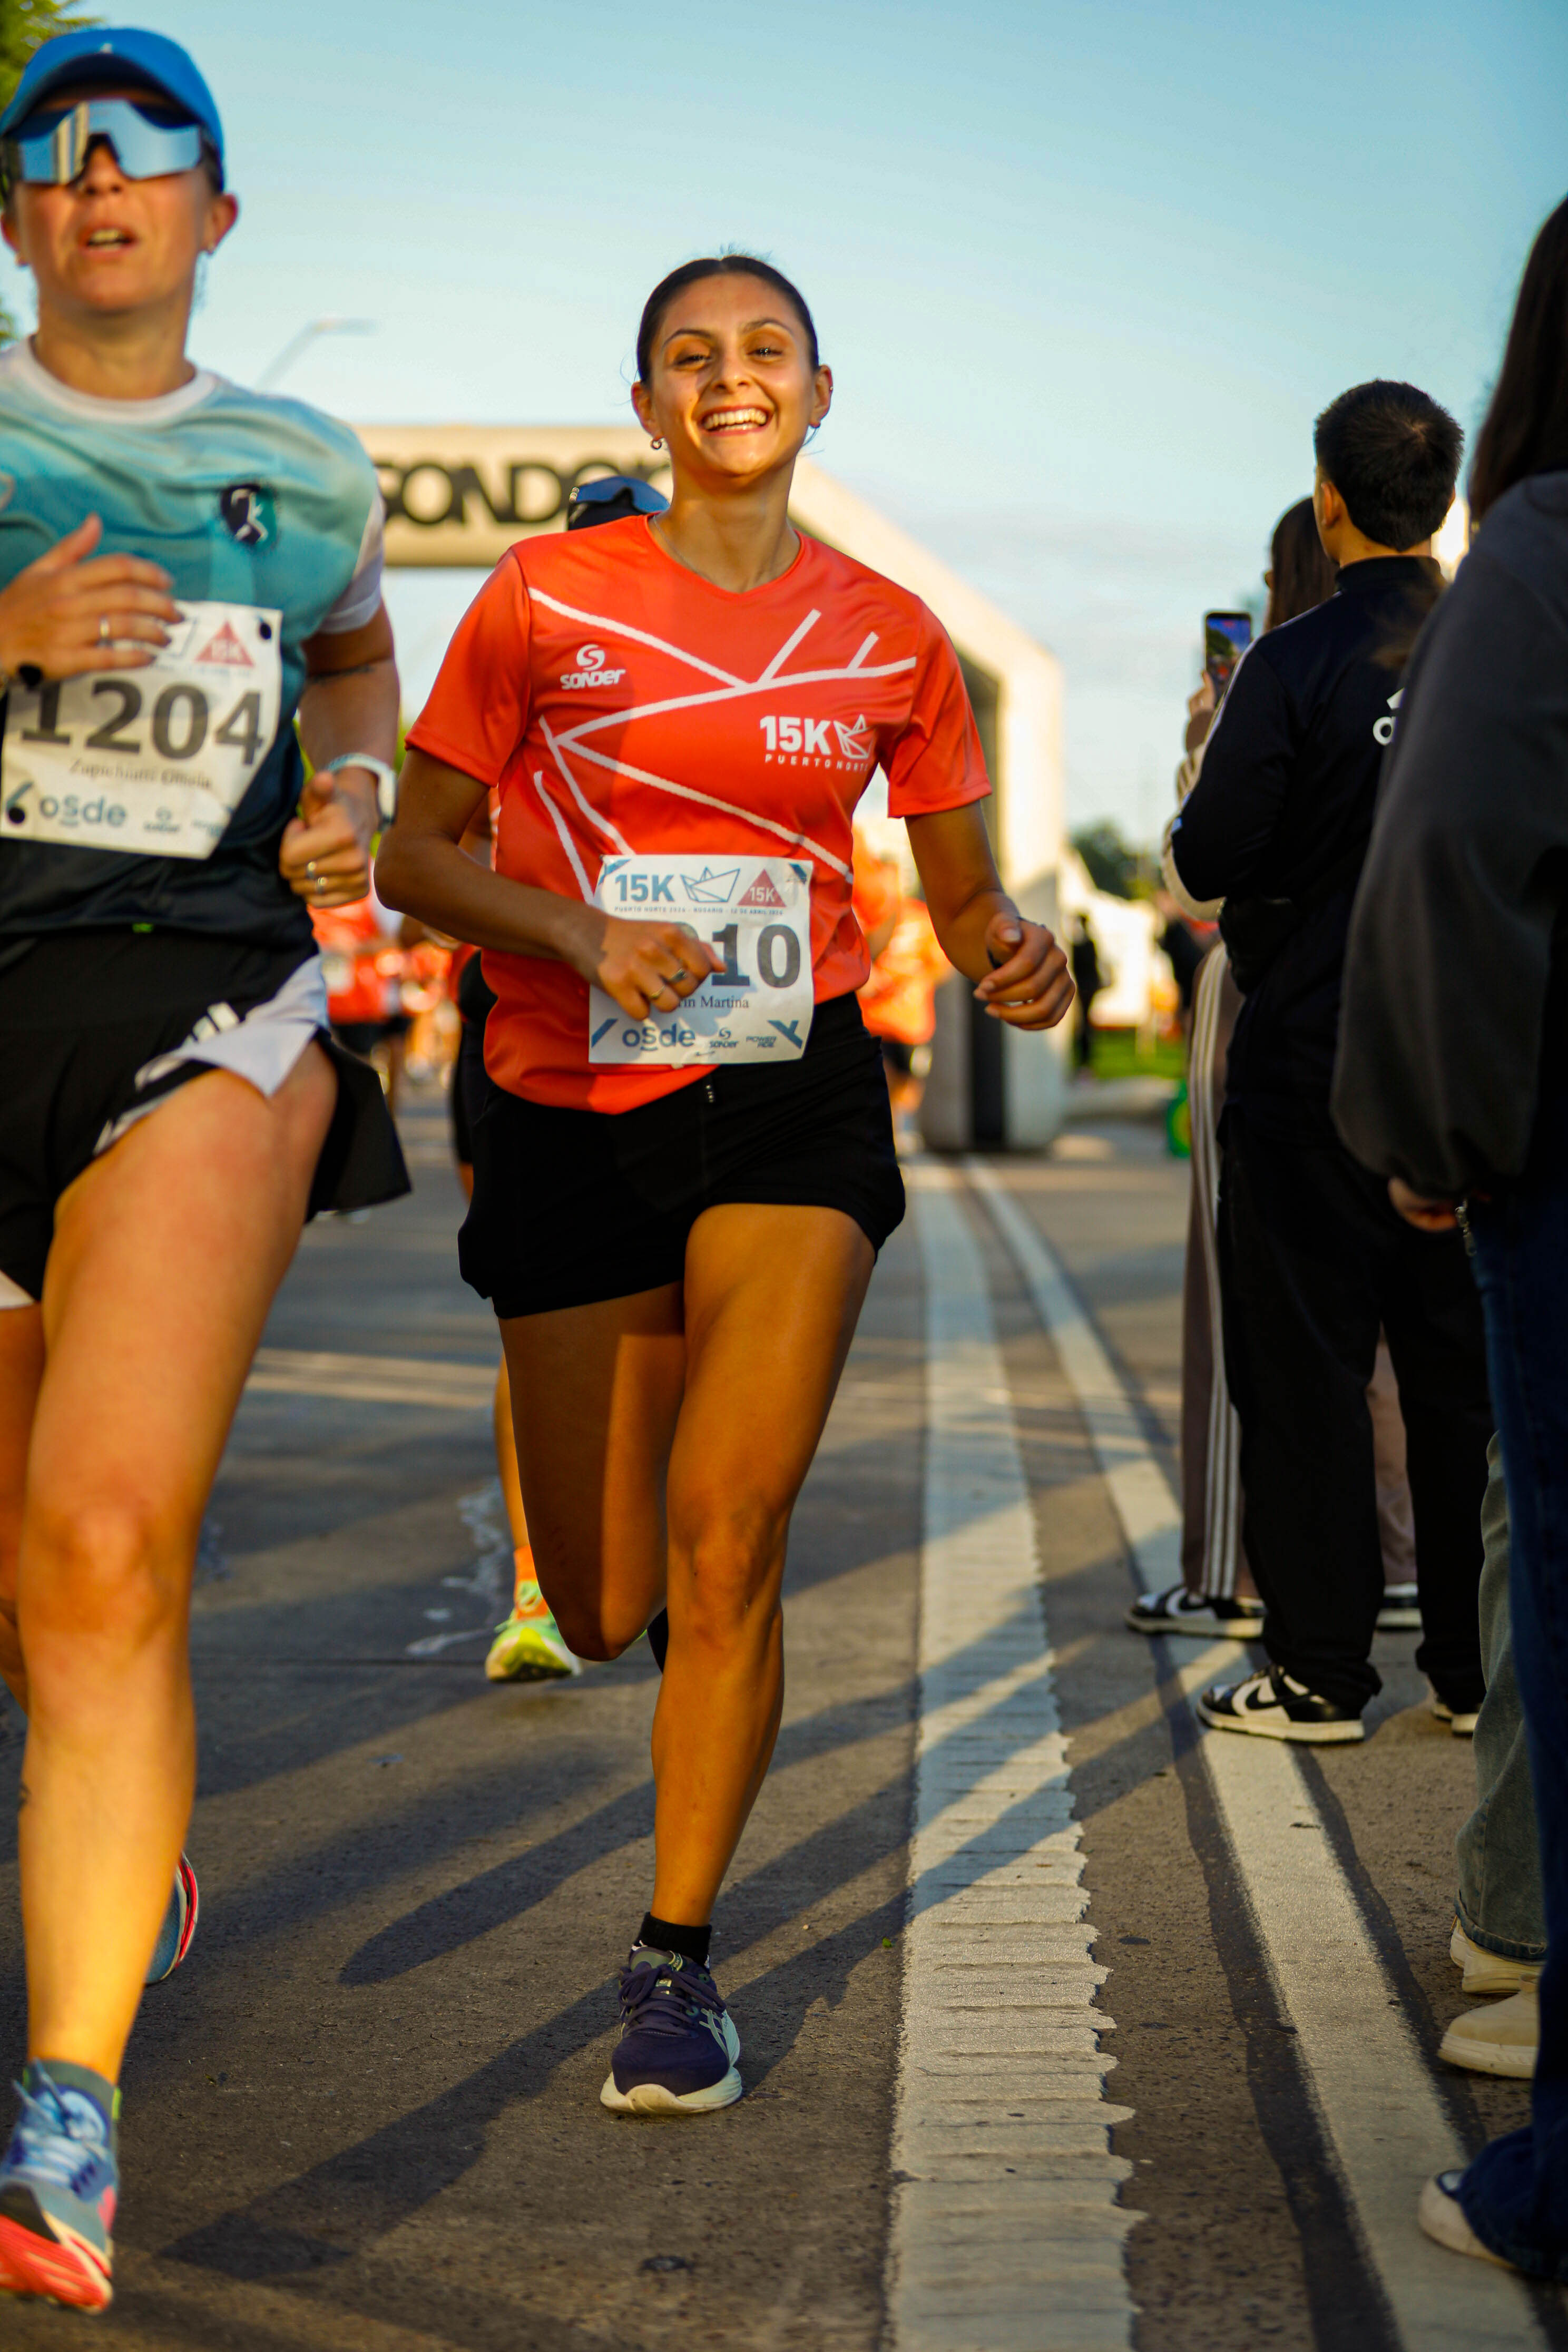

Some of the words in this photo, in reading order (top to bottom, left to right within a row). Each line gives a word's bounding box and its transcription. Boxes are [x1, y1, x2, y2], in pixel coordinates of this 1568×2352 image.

[21, 678, 263, 766] 1204
[759, 715, 832, 756] 15K
[765, 753, 831, 769] PUERTO
[40, 795, 126, 827] osde
[614, 873, 675, 902] 15K
[749, 886, 775, 903] 15K
[677, 922, 801, 988] 10
[700, 995, 749, 1008] Martina
[622, 1023, 695, 1049] osde
